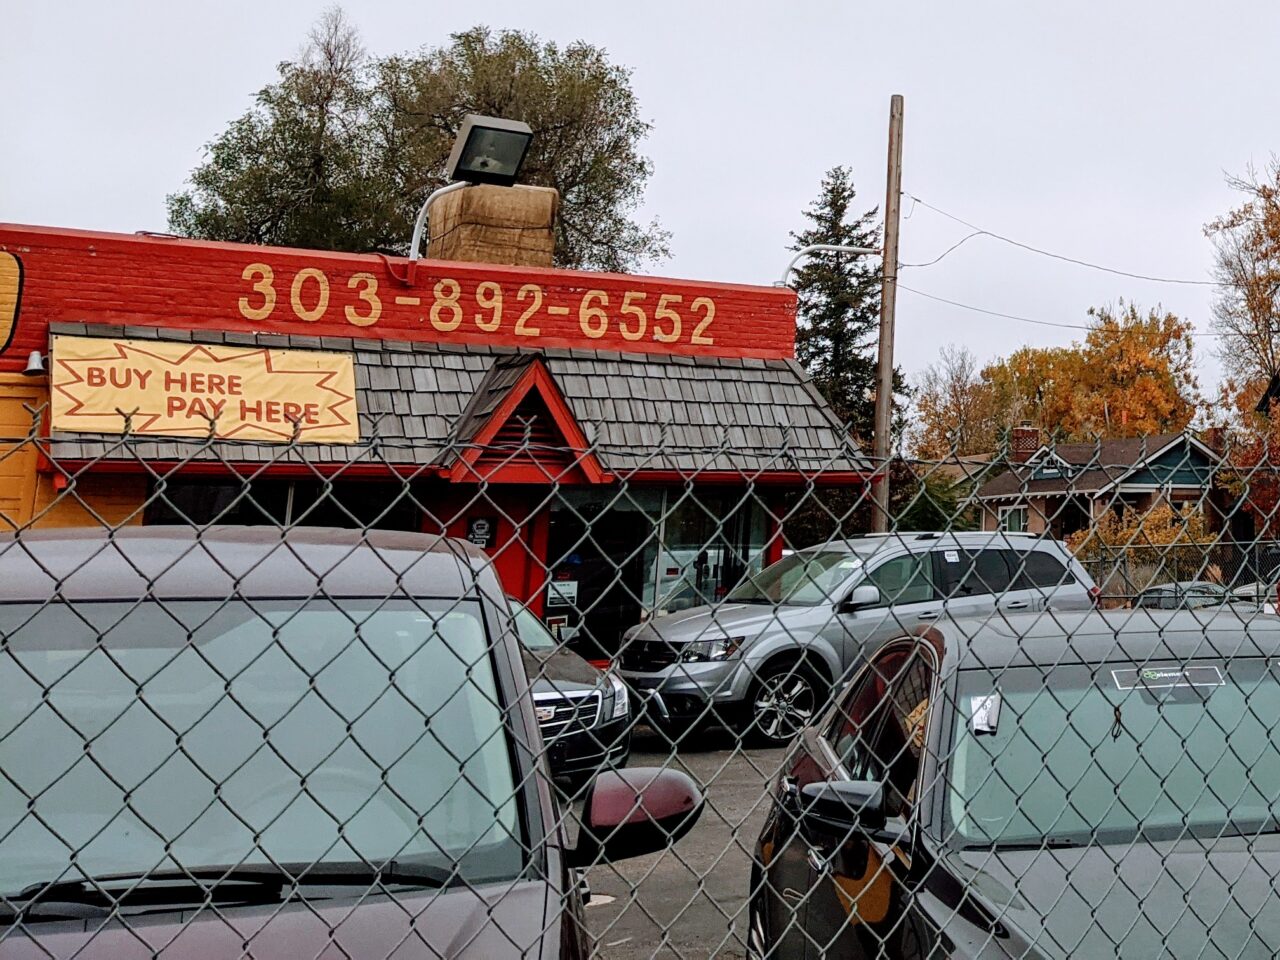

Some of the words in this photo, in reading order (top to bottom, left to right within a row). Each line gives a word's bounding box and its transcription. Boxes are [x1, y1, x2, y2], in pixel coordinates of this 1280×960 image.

[238, 262, 716, 345] 303-892-6552
[87, 367, 152, 389] BUY
[164, 370, 242, 395] HERE
[167, 396, 227, 419] PAY
[240, 400, 319, 424] HERE
